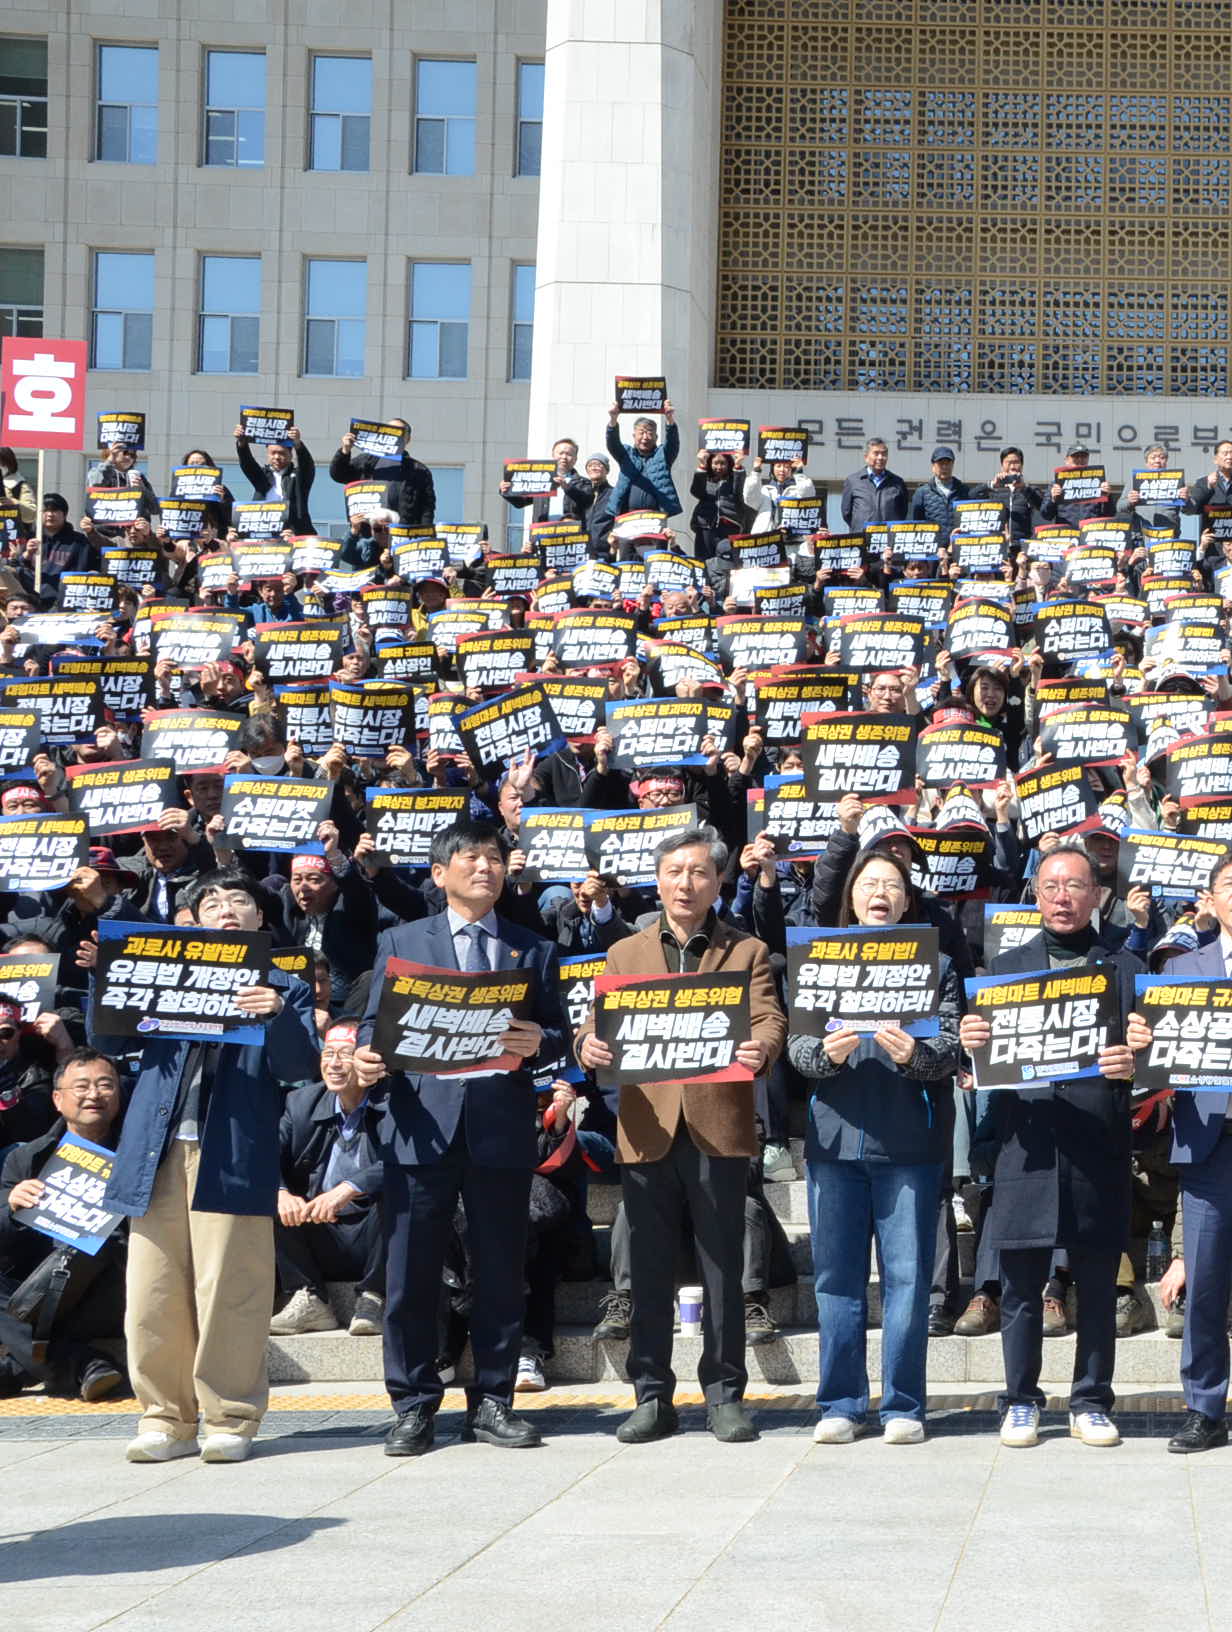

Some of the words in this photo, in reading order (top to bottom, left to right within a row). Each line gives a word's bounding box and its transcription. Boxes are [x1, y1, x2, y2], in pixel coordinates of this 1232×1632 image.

[8, 353, 75, 434] 호
[896, 419, 1003, 450] 권력은
[260, 630, 299, 642] 골목상권
[301, 629, 341, 642] 생존위협
[722, 621, 762, 635] 골목상권
[764, 621, 802, 634] 생존위협
[845, 620, 884, 633] 골목상권
[884, 621, 922, 634] 생존위협
[1045, 618, 1103, 636] 수퍼마켓
[731, 633, 796, 651] 새벽배송
[849, 634, 914, 650] 새벽배송
[1044, 634, 1109, 653] 다죽는다!
[267, 644, 331, 662] 새벽배송
[733, 649, 797, 666] 결사반대
[849, 649, 916, 667] 결사반대
[268, 659, 334, 677] 결사반대
[363, 693, 409, 706] 새벽배송
[333, 708, 402, 728] 전통시장
[461, 708, 500, 732] 대형마트
[501, 691, 543, 712] 새벽배송
[613, 705, 658, 719] 골목상권
[660, 703, 703, 717] 붕괴막자
[333, 726, 404, 745] 다죽는다!
[475, 708, 542, 745] 전통시장
[620, 719, 697, 737] 수퍼마켓
[807, 725, 851, 741] 골목상권
[856, 725, 911, 741] 생존위협
[618, 732, 699, 753] 다죽는다!
[922, 731, 960, 745] 골목상권
[962, 732, 1001, 747] 생존위협
[815, 744, 899, 767] 새벽배송
[925, 746, 995, 763] 새벽배송
[73, 774, 120, 790] 골목상권
[123, 768, 171, 783] 생존위협
[819, 767, 902, 791] 결사반대
[927, 762, 996, 781] 결사반대
[81, 784, 162, 807] 새벽배송
[229, 781, 275, 796] 골목상권
[278, 783, 327, 799] 붕괴막자
[234, 799, 318, 821] 수퍼마켓
[227, 817, 318, 839] 다죽는다!
[123, 937, 182, 958] 과로사
[184, 941, 248, 963] 유발법!
[809, 943, 858, 959] 과로사
[860, 942, 918, 960] 유발법!
[107, 960, 183, 986] 유통법
[797, 965, 858, 986] 유통법
[864, 963, 931, 986] 개정안
[101, 987, 154, 1010] 즉각
[391, 977, 465, 1003] 골목상권
[469, 981, 528, 1005] 생존위협
[604, 991, 671, 1009] 골목상권
[675, 987, 742, 1007] 생존위협
[977, 984, 1039, 1006] 대형마트
[1042, 975, 1108, 998] 새벽배송
[1144, 987, 1209, 1007] 대형마트
[794, 990, 836, 1012] 즉각
[839, 990, 933, 1014] 철회하라!
[398, 1003, 512, 1035] 새벽배송
[617, 1012, 730, 1040] 새벽배송
[991, 999, 1099, 1034] 전통시장
[620, 1040, 734, 1070] 결사반대
[989, 1027, 1107, 1064] 다죽는다!
[56, 1144, 106, 1173] 대형마트
